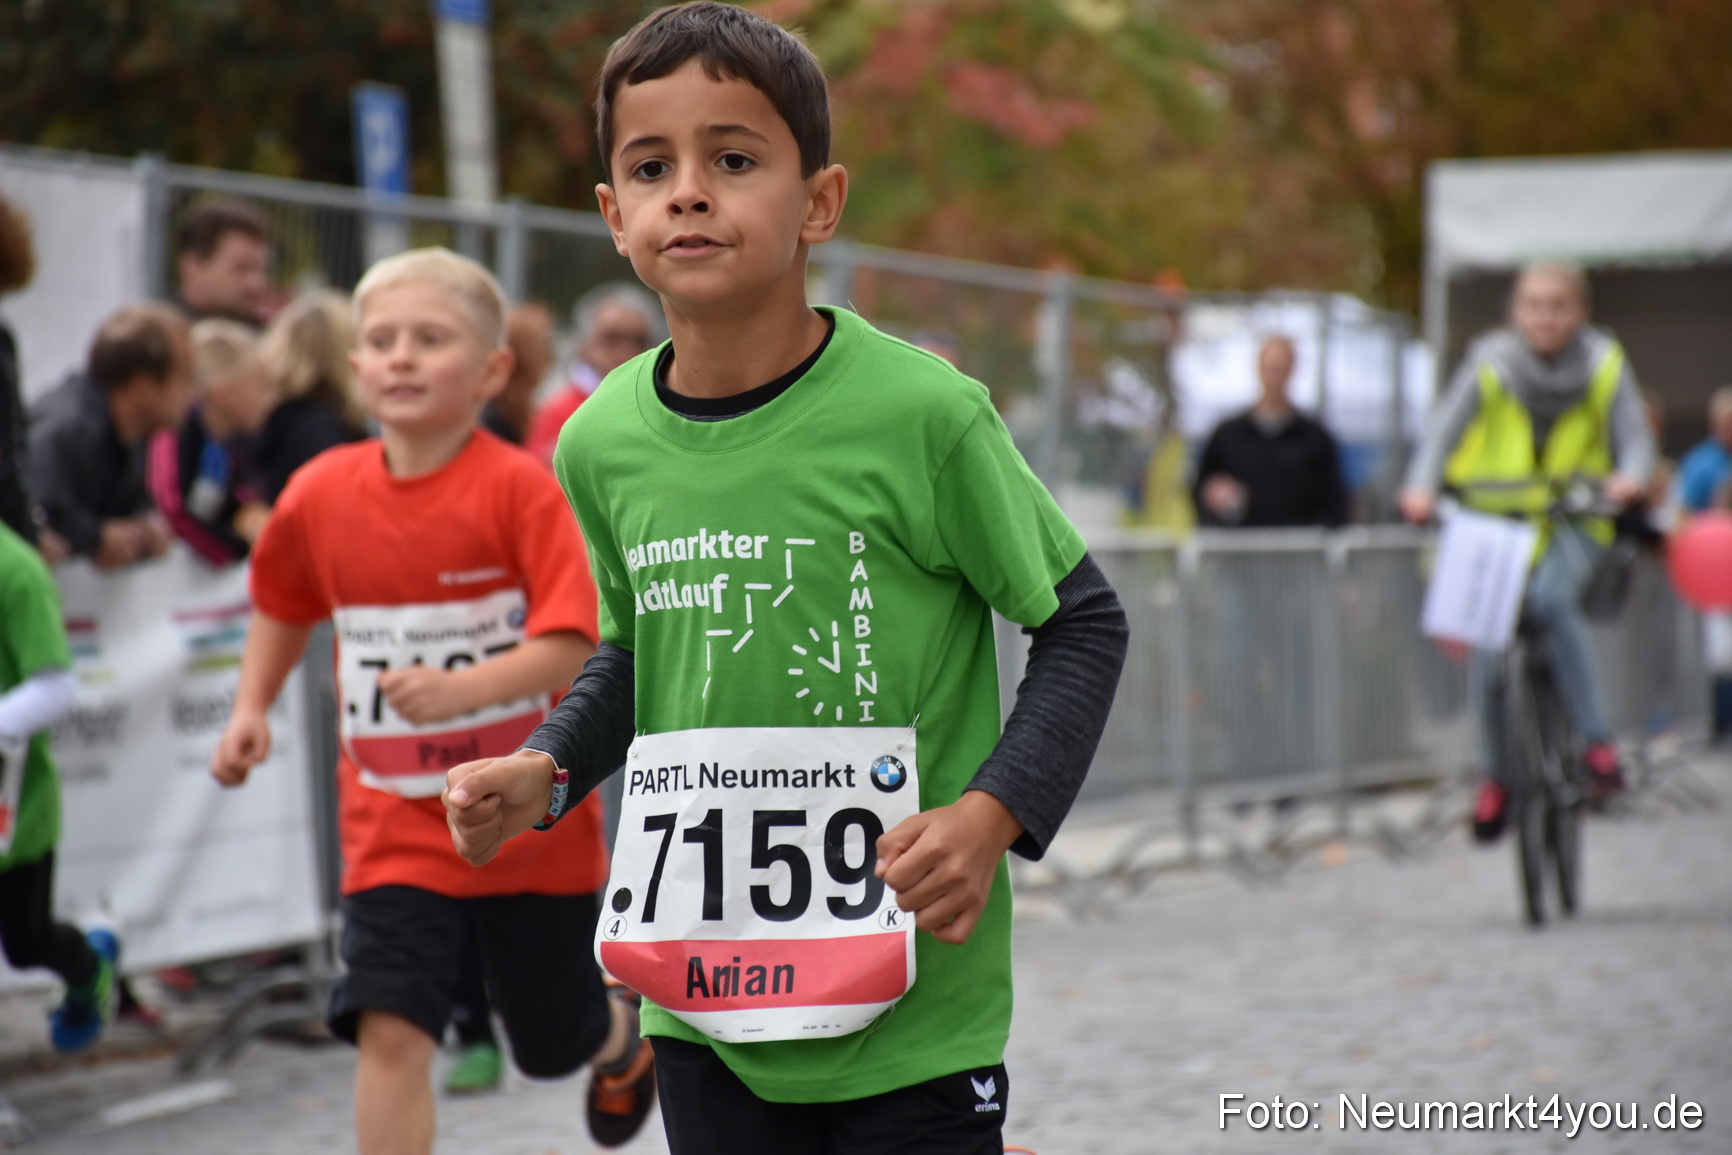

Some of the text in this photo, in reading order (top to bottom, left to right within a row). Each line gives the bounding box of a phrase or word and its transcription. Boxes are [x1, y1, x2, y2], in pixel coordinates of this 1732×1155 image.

[622, 527, 769, 574] eumarkter
[849, 531, 878, 723] BAMBINI
[417, 737, 481, 767] Paul
[629, 761, 856, 796] PARTL Neumarkt
[641, 807, 886, 923] 7159
[609, 919, 620, 937] 4
[886, 909, 899, 927] K
[975, 1101, 1001, 1113] erima
